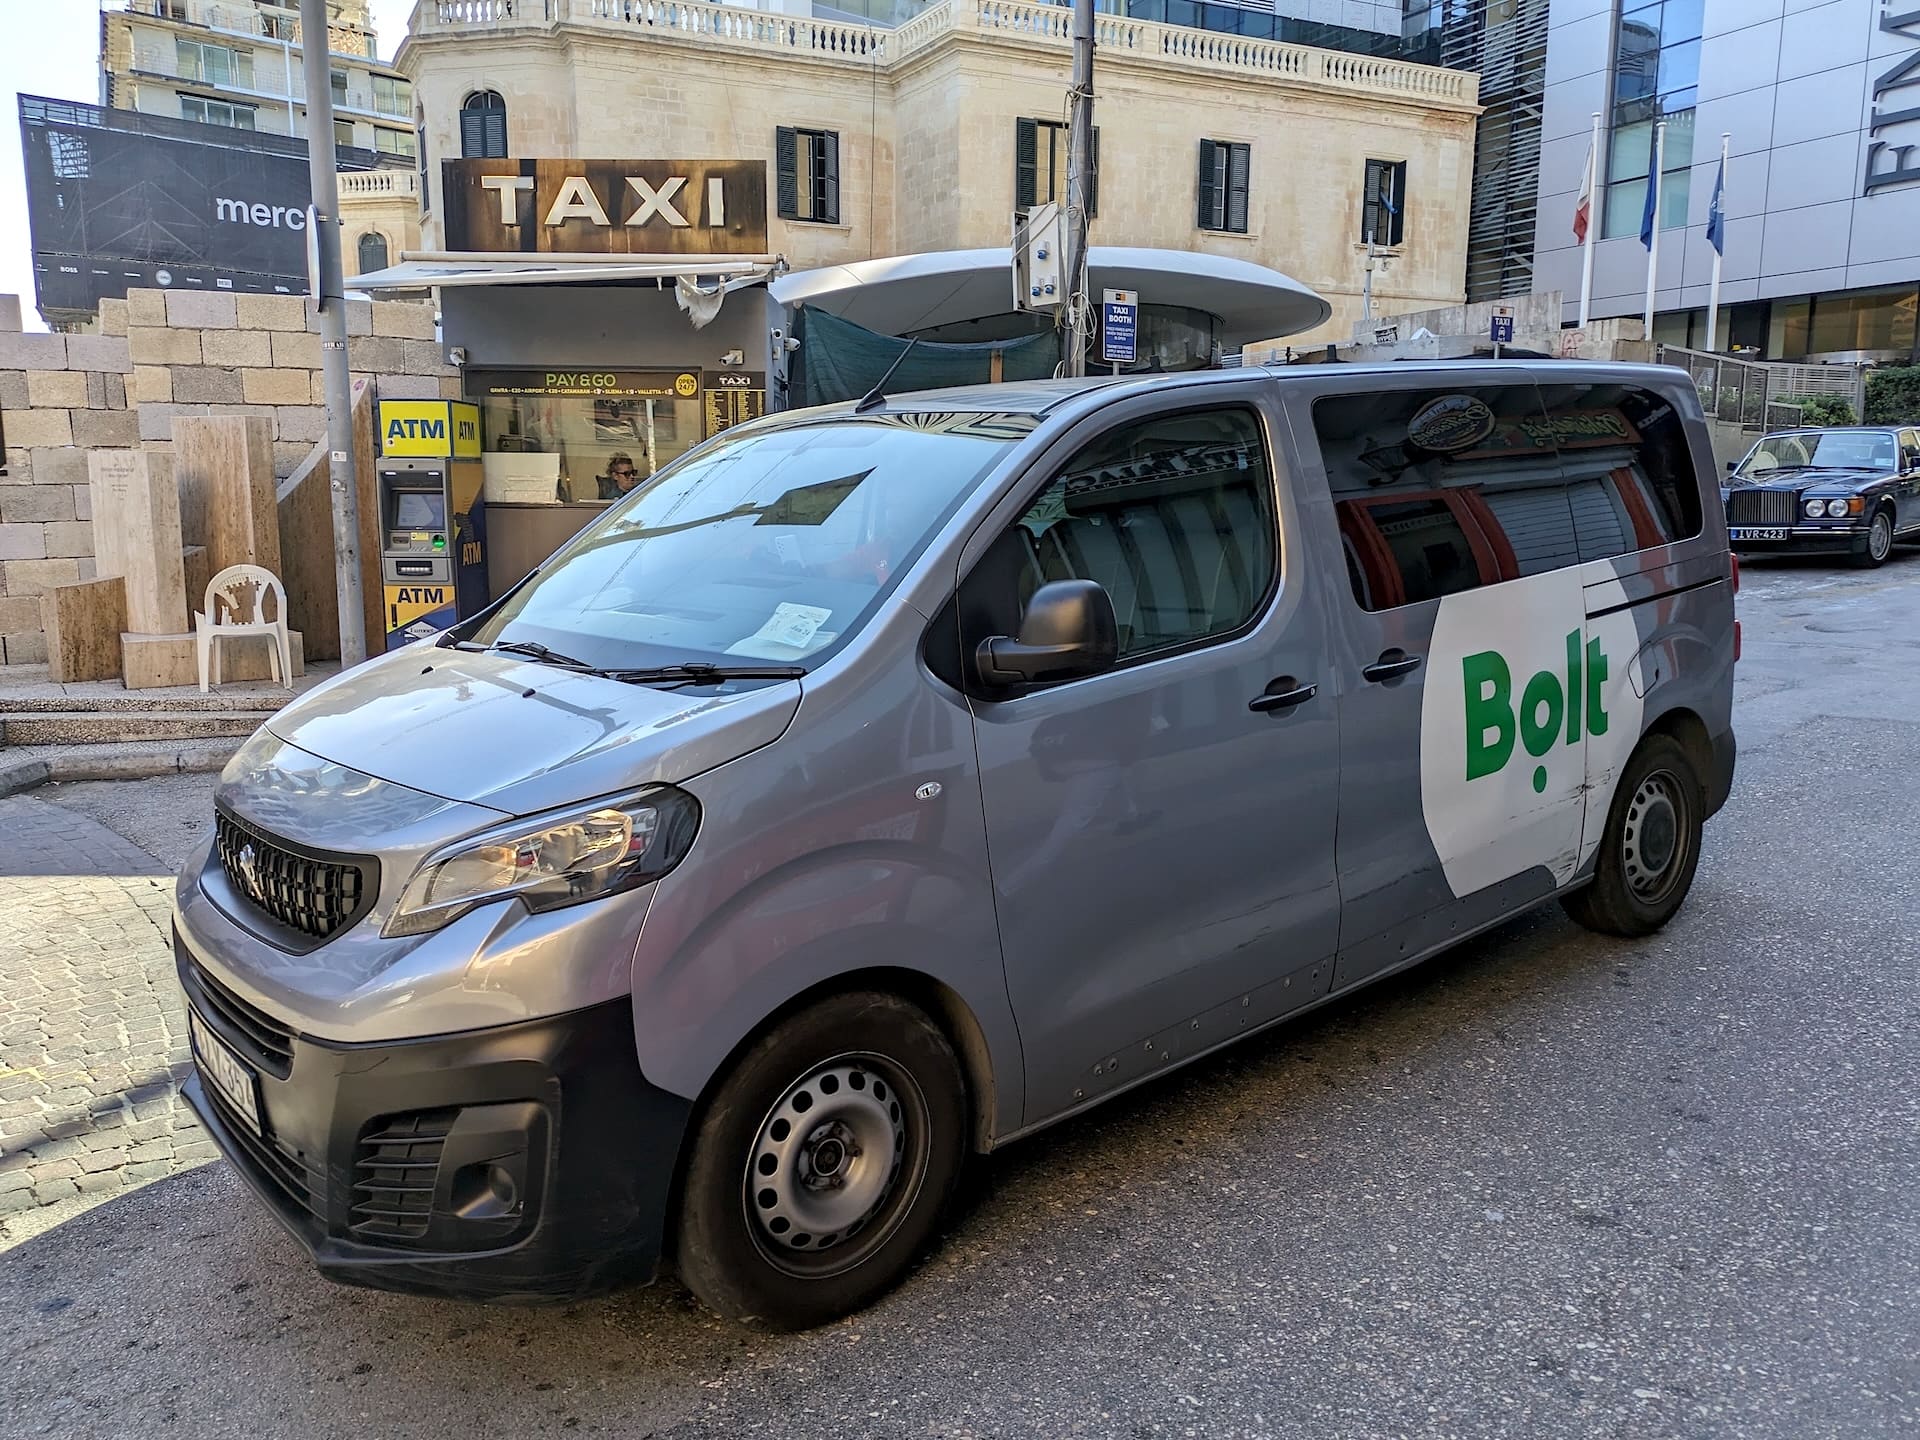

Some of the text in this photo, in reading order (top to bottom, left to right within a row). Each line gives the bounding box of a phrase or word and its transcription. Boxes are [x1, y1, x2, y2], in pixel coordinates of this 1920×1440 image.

[1863, 0, 1920, 197] FIM
[481, 175, 725, 227] TAXI
[216, 197, 305, 231] merc
[1108, 314, 1132, 324] BOOTH
[1112, 306, 1128, 314] TAXI
[1495, 317, 1510, 326] TAXI
[719, 377, 751, 385] TAXI
[387, 419, 445, 439] ATM
[458, 420, 475, 441] ATM
[1739, 530, 1784, 539] IVR-423
[462, 541, 482, 567] ATM
[397, 588, 444, 604] ATM
[1462, 627, 1608, 793] Bolt
